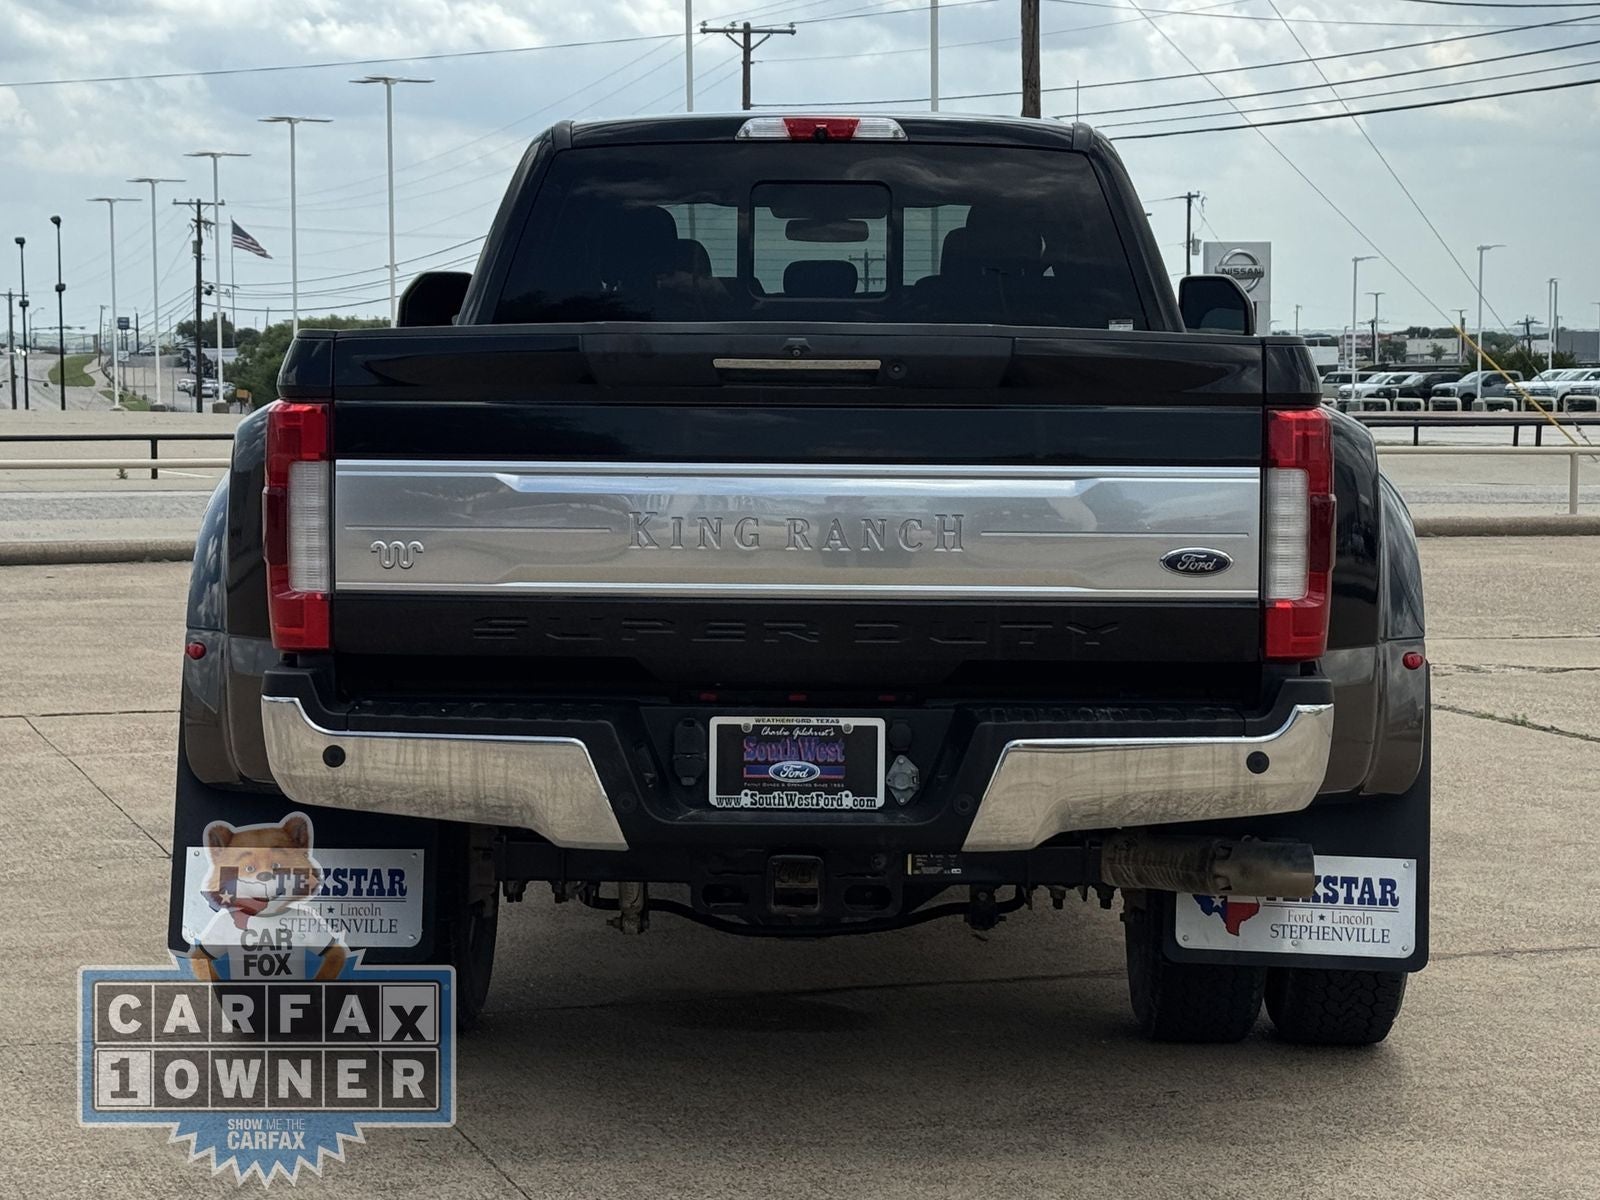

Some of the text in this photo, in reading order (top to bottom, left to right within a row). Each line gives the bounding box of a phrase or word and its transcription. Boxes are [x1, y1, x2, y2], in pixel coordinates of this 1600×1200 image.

[1221, 267, 1261, 275] NISSAN
[627, 511, 966, 554] KING RANCH
[1177, 553, 1217, 571] Ford
[473, 617, 1119, 645] SUPER DUTY
[743, 737, 846, 763] SouthWest
[779, 764, 809, 779] Ford
[716, 792, 877, 808] www.SouthWestFord.com
[272, 867, 408, 897] TEXSTAR
[340, 903, 382, 917] Lincoln
[1287, 909, 1373, 926] Ford Lincoln
[279, 917, 398, 934] STEPHENVILLE
[1269, 923, 1391, 944] STEPHENVILLE
